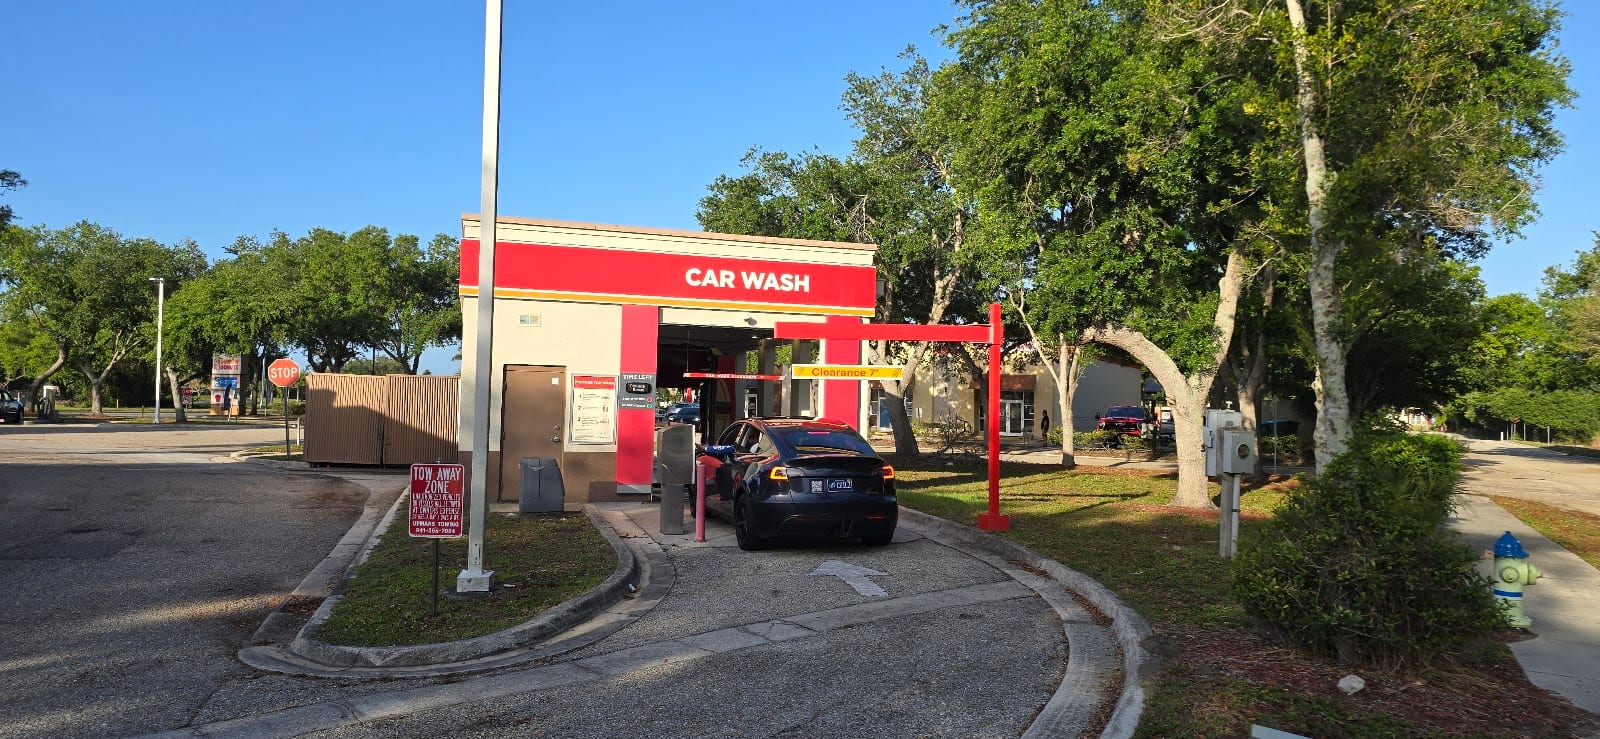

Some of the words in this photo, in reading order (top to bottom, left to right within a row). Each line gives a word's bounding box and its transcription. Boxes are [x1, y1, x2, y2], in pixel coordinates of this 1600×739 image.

[685, 267, 735, 288] CAR
[741, 271, 810, 293] WASH
[271, 367, 298, 379] STOP
[811, 367, 866, 377] Clearance
[870, 368, 879, 377] 7'
[413, 467, 433, 480] TOW
[437, 467, 462, 480] AWAY
[425, 480, 449, 494] ZONE
